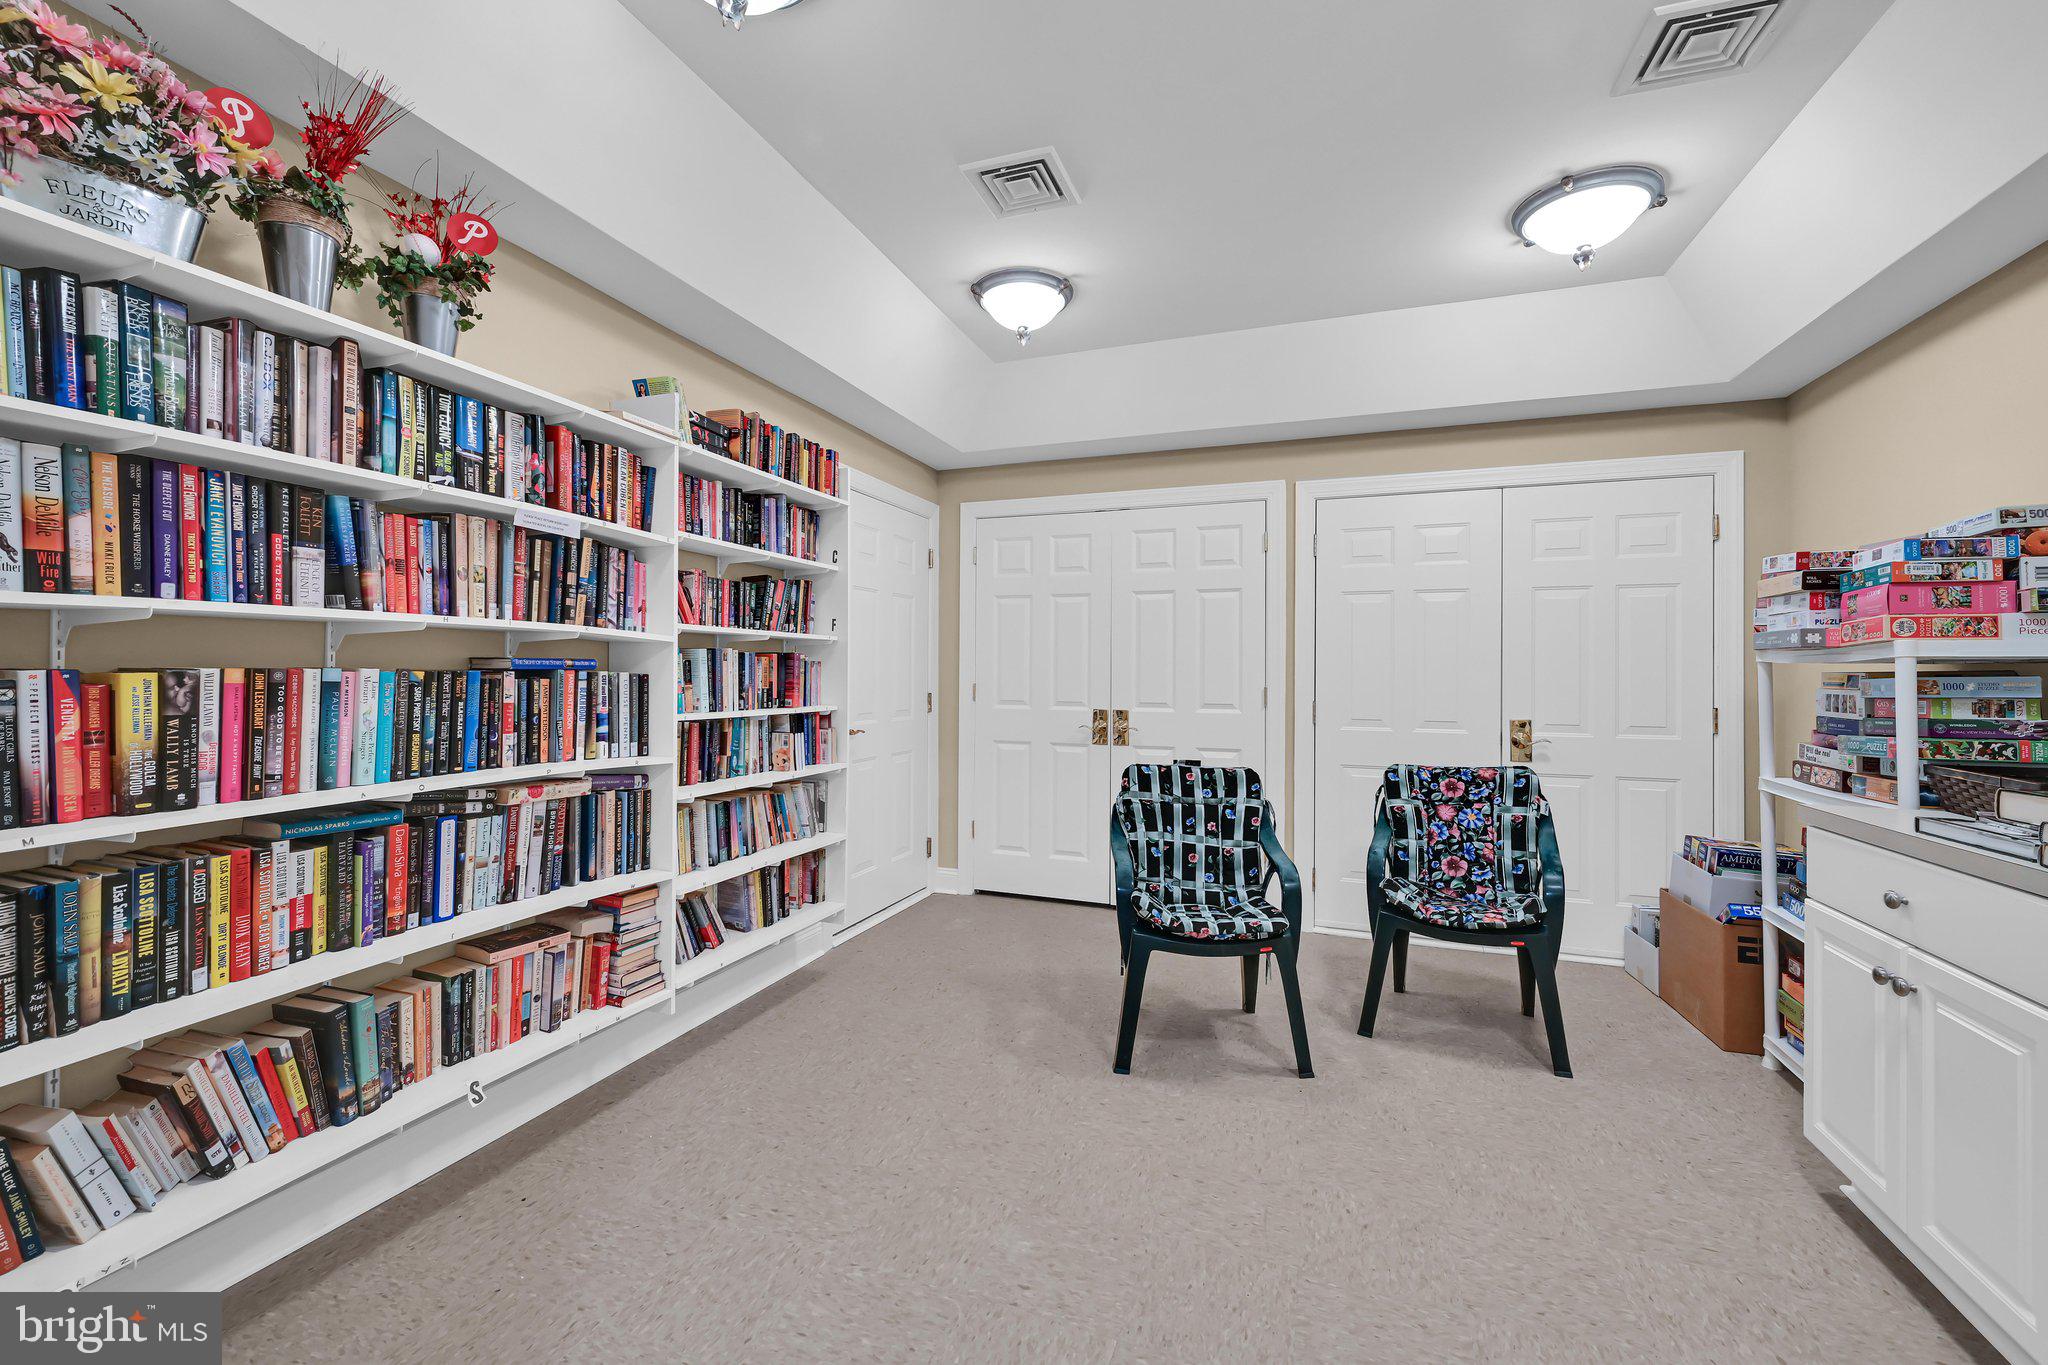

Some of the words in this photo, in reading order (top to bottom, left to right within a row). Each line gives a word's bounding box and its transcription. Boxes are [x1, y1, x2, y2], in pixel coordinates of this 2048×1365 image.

[221, 97, 254, 137] P
[43, 178, 150, 224] FLEURS
[92, 203, 104, 213] &
[59, 204, 133, 235] JARDIN
[458, 220, 488, 244] P
[346, 344, 355, 360] THE
[103, 341, 116, 407] QUENTINS
[346, 368, 355, 384] VINCI
[67, 383, 77, 402] MAN
[346, 386, 355, 403] CODE
[439, 393, 450, 412] TOM
[346, 418, 355, 432] DAN
[439, 414, 451, 450] CLANCY
[346, 432, 355, 454] BROWN
[34, 456, 57, 492] Nelson
[101, 461, 112, 474] THE
[162, 470, 172, 484] THE
[417, 465, 424, 476] ME
[102, 476, 112, 510] MEASURE
[183, 473, 196, 492] JANET
[209, 478, 224, 508] JANET
[162, 484, 172, 508] DEEPEST
[183, 491, 197, 521] EVANOVICH
[35, 495, 59, 537] DeMille
[133, 508, 141, 532] HORSE
[162, 509, 172, 522] CUT
[251, 510, 258, 518] TO
[299, 495, 311, 536] FOLLETT
[312, 507, 322, 528] KEN
[104, 540, 113, 560] NIKKI
[187, 532, 196, 550] TRICKY
[210, 511, 225, 566] EVANOVICH
[36, 551, 61, 565] Wild
[133, 532, 142, 571] WHISPERER
[832, 550, 838, 564] C
[40, 565, 59, 578] Fire
[105, 562, 114, 585] ERLICK
[299, 561, 311, 599] ETERNITY
[832, 618, 837, 632] F
[2018, 618, 2046, 626] 1000
[88, 687, 99, 699] IRIS
[143, 678, 152, 708] JONATHAN
[203, 672, 215, 702] WILLIAM
[255, 672, 264, 690] JOHN
[399, 670, 408, 698] Cilka's
[1942, 682, 1965, 691] 1000
[413, 686, 422, 702] SARA
[60, 697, 74, 741] VENDETTA
[89, 700, 100, 728] JOHANSEN
[254, 690, 263, 730] LESCROART
[397, 698, 407, 729] Journey
[412, 702, 421, 732] PARETSKY
[143, 708, 152, 741] KELLERMAN
[166, 718, 179, 756] WALLY
[183, 739, 189, 747] IS
[253, 735, 262, 763] TREASURE
[276, 733, 283, 744] TO
[1867, 743, 1887, 752] PUZZLE
[89, 750, 100, 768] KILLER
[276, 745, 282, 755] BE
[411, 733, 420, 771] BREAKDOWN
[3, 770, 11, 786] PAM
[89, 768, 101, 790] DREAMS
[129, 750, 143, 796] HOLLYWOOD
[144, 760, 156, 787] GOLEM
[166, 760, 179, 791] LAMB
[253, 764, 262, 779] HUNT
[4, 786, 12, 807] JENOFF
[64, 766, 77, 813] JOHANSEN
[285, 824, 323, 835] NICHOLAS
[324, 821, 350, 830] SPARKS
[549, 810, 557, 829] BRAD
[22, 838, 35, 847] M
[395, 829, 404, 856] Daniel
[547, 831, 555, 850] THOR
[219, 859, 229, 875] LISA
[259, 851, 270, 869] LISA
[276, 852, 286, 865] LISA
[296, 854, 305, 866] LISA
[394, 857, 404, 878] Silva
[112, 883, 128, 903] Lisa
[139, 872, 154, 896] LISA
[193, 868, 206, 903] ACCUSED
[259, 871, 270, 914] SCOTTOLINE
[276, 865, 286, 900] SCOTTOLINE
[296, 866, 305, 896] SCOTTOLINE
[63, 890, 78, 923] JOHN
[219, 876, 229, 915] SCOTTOLINE
[30, 913, 45, 945] JOHN
[112, 904, 128, 945] Scottoline
[138, 897, 154, 958] SCOTTOLINE
[218, 922, 227, 942] DIRTY
[236, 913, 250, 939] LOOK
[259, 924, 270, 943] DEAD
[63, 925, 78, 954] SAUL
[165, 930, 178, 946] LISA
[33, 948, 46, 978] SAUL
[165, 946, 178, 982] SCOTTOLINE
[217, 945, 226, 970] BLONDE
[236, 941, 249, 968] AGAIN
[258, 944, 269, 971] RINGER
[111, 949, 129, 997] LOYALTY
[4, 983, 16, 1013] DEVIL'S
[4, 1016, 17, 1039] CODE
[470, 1081, 484, 1104] S
[2, 1173, 16, 1192] LUCK
[9, 1192, 23, 1213] JANE
[15, 1211, 33, 1240] SMILEY
